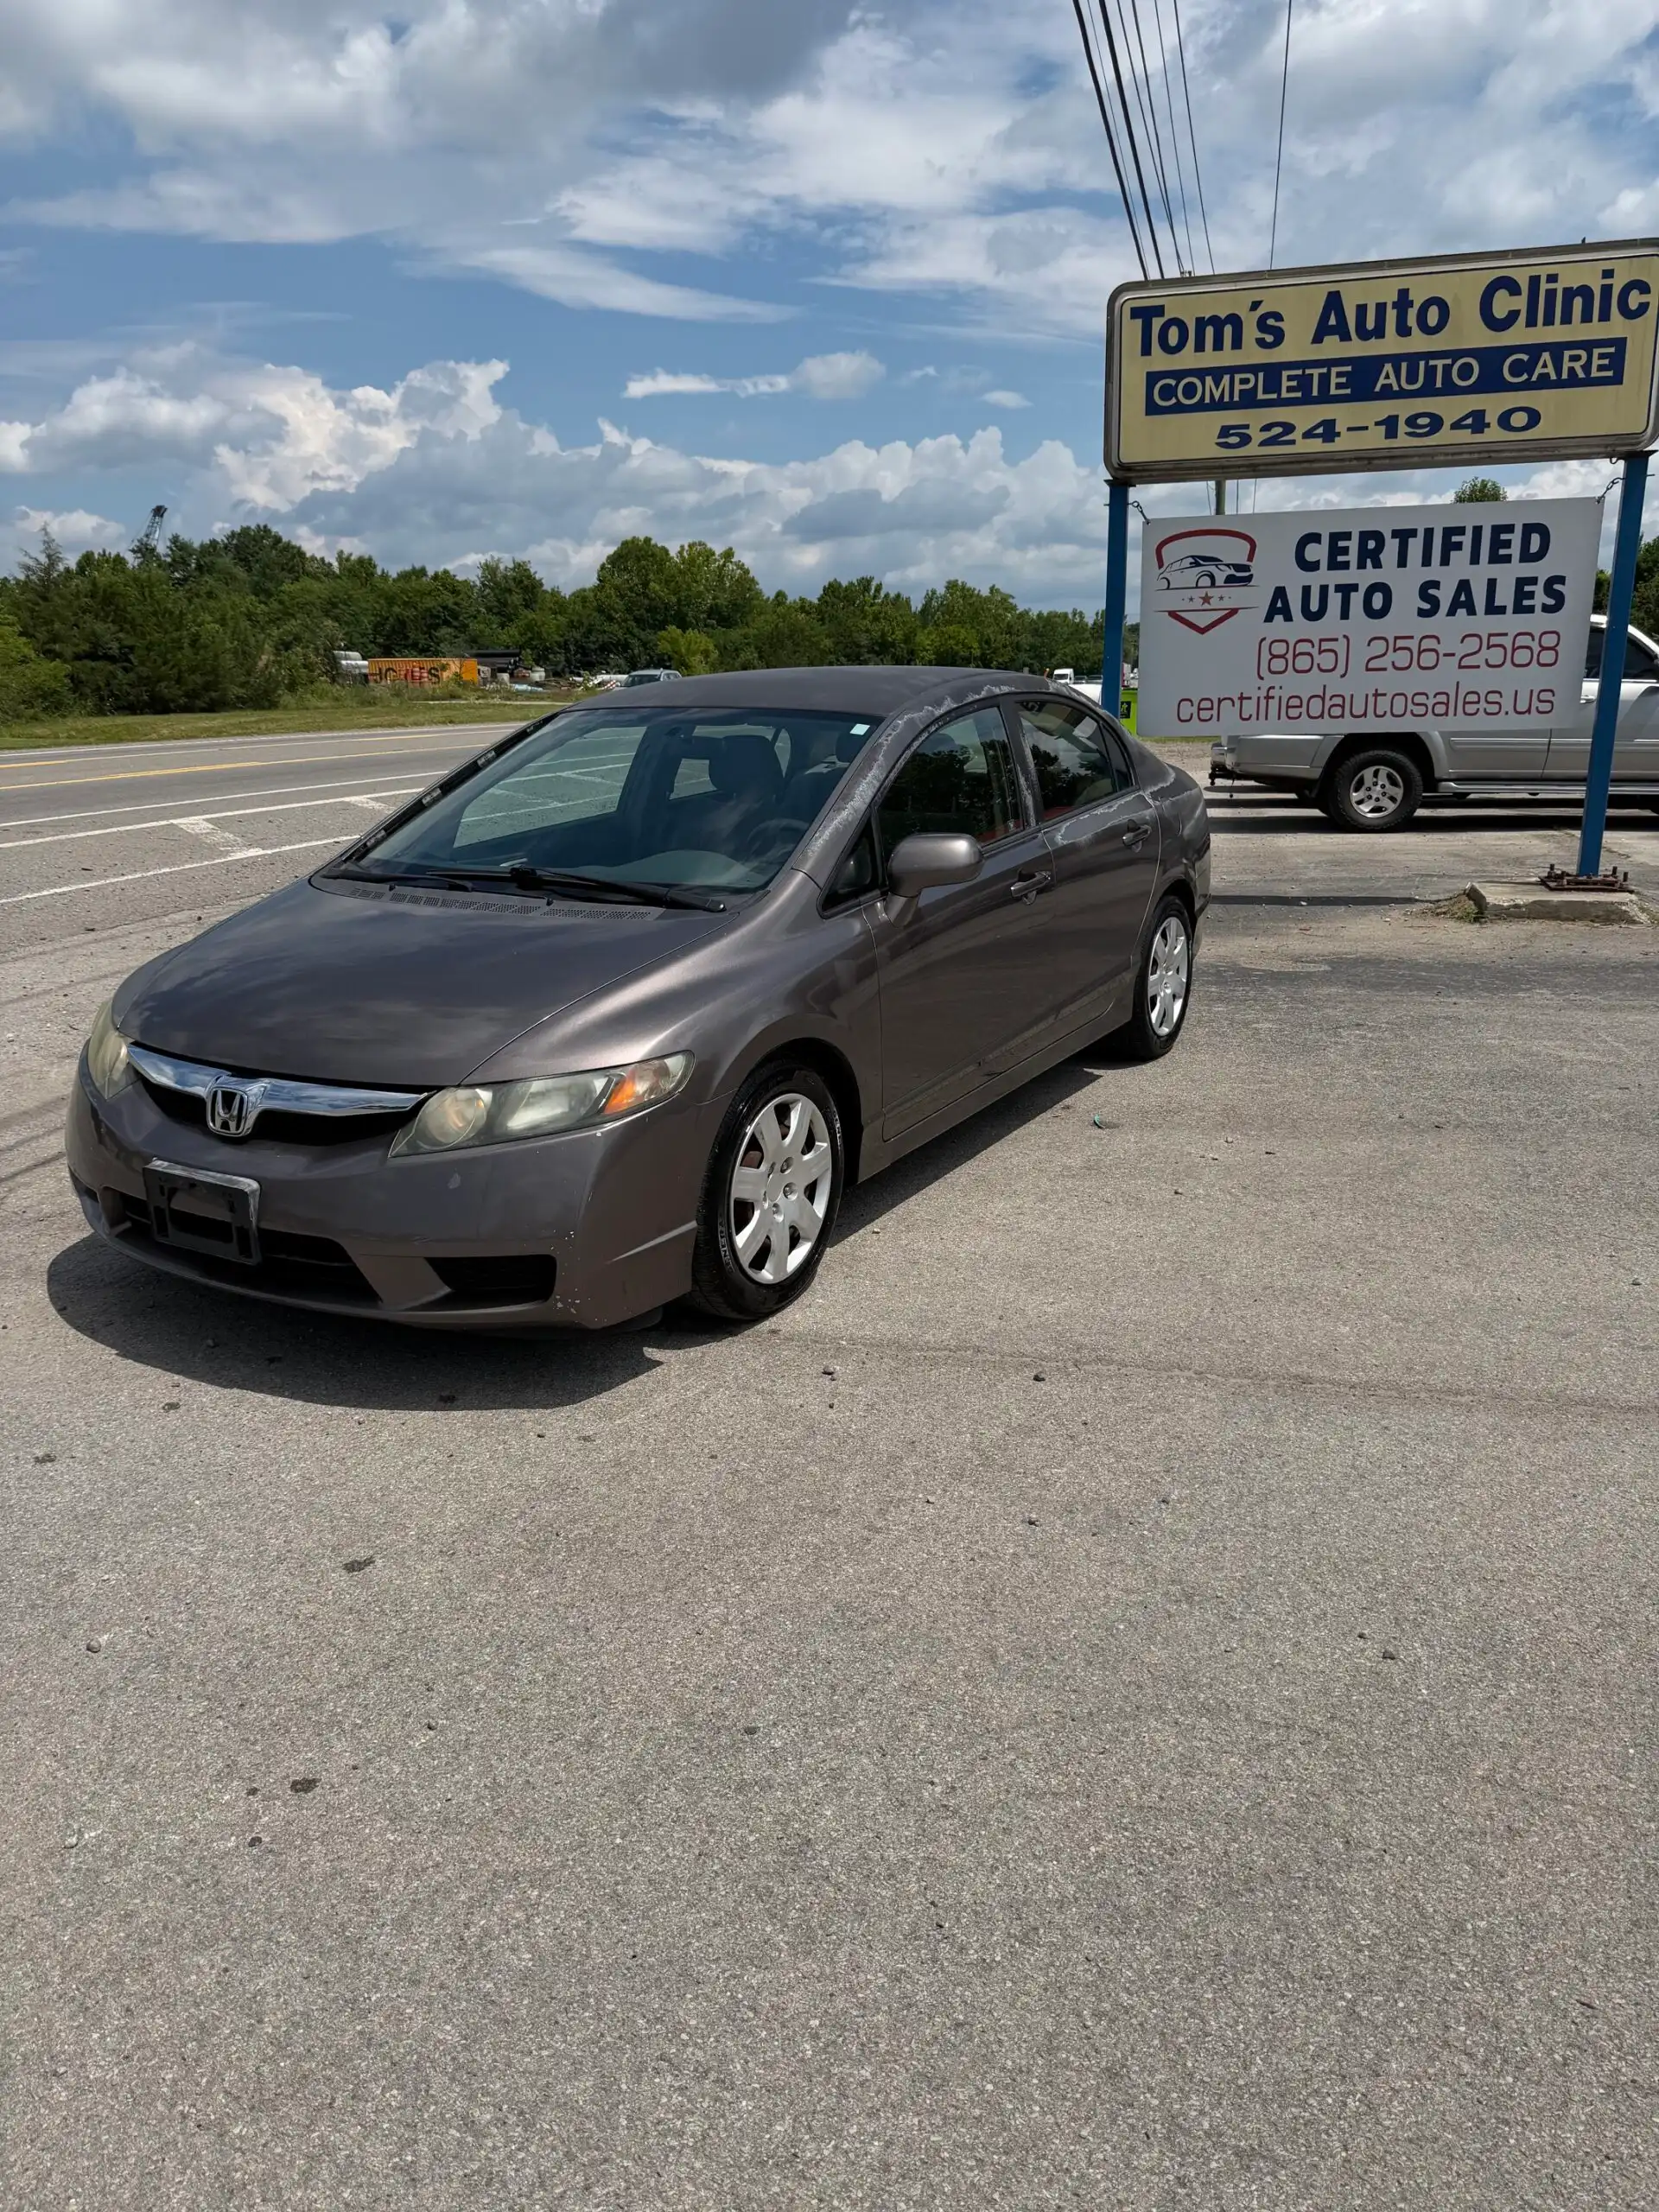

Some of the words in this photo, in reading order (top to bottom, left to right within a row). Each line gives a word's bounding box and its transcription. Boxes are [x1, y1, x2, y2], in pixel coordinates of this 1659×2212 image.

[1129, 299, 1286, 357] Tom's
[1310, 287, 1451, 345] Auto
[1478, 268, 1652, 333] Clinic
[1152, 365, 1352, 407] COMPLETE
[1374, 358, 1480, 393] AUTO
[1502, 346, 1616, 383] CARE
[1214, 406, 1541, 450] 524-1940
[1294, 522, 1551, 573] CERTIFIED
[1262, 582, 1393, 624] AUTO
[1416, 575, 1567, 619] SALES
[1256, 635, 1351, 679] (865)
[1364, 630, 1560, 671] 256-2568
[1176, 681, 1555, 723] certifiedautosales.us
